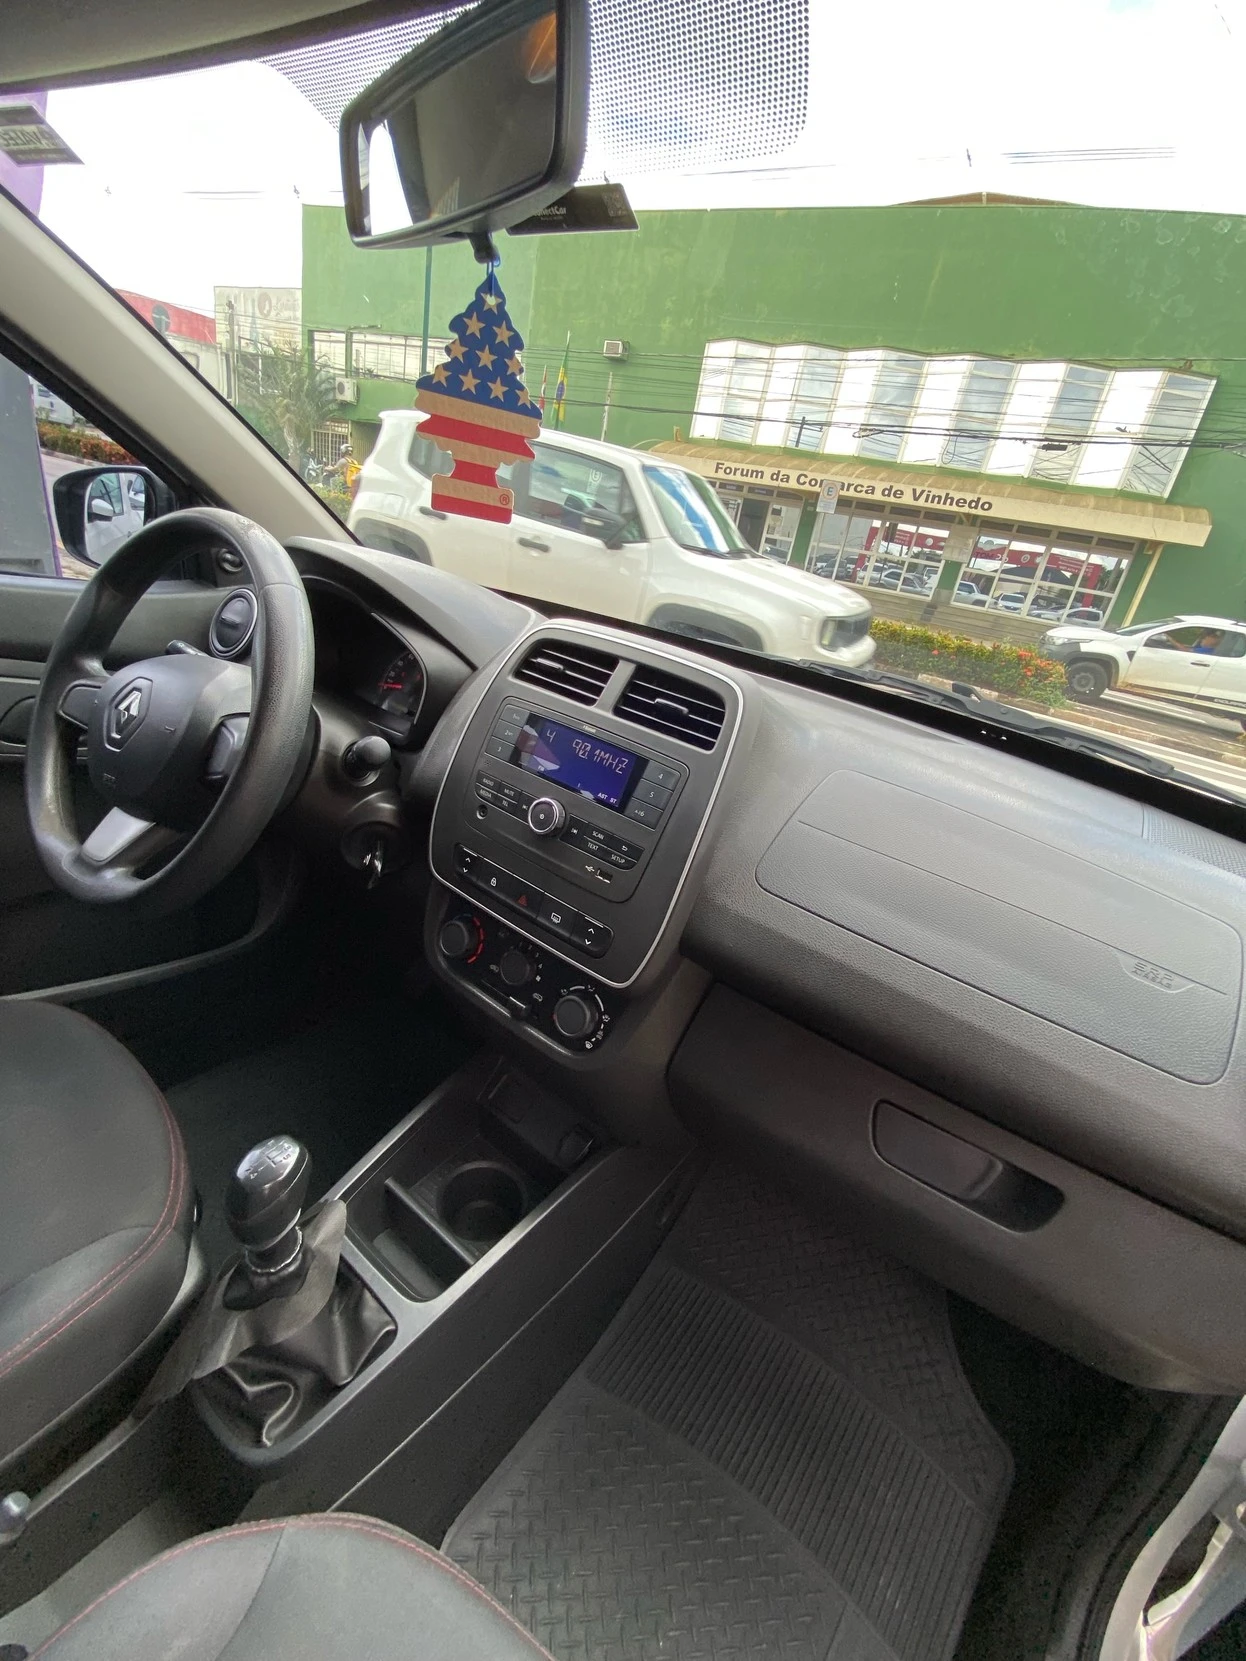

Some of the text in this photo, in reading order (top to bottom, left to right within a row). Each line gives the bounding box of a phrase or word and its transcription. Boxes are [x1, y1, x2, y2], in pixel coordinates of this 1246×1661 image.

[714, 462, 993, 511] Forum da Coarca de Vinhedo
[826, 486, 835, 497] E
[592, 830, 605, 840] SCAN
[587, 842, 626, 863] TEXT SETUP
